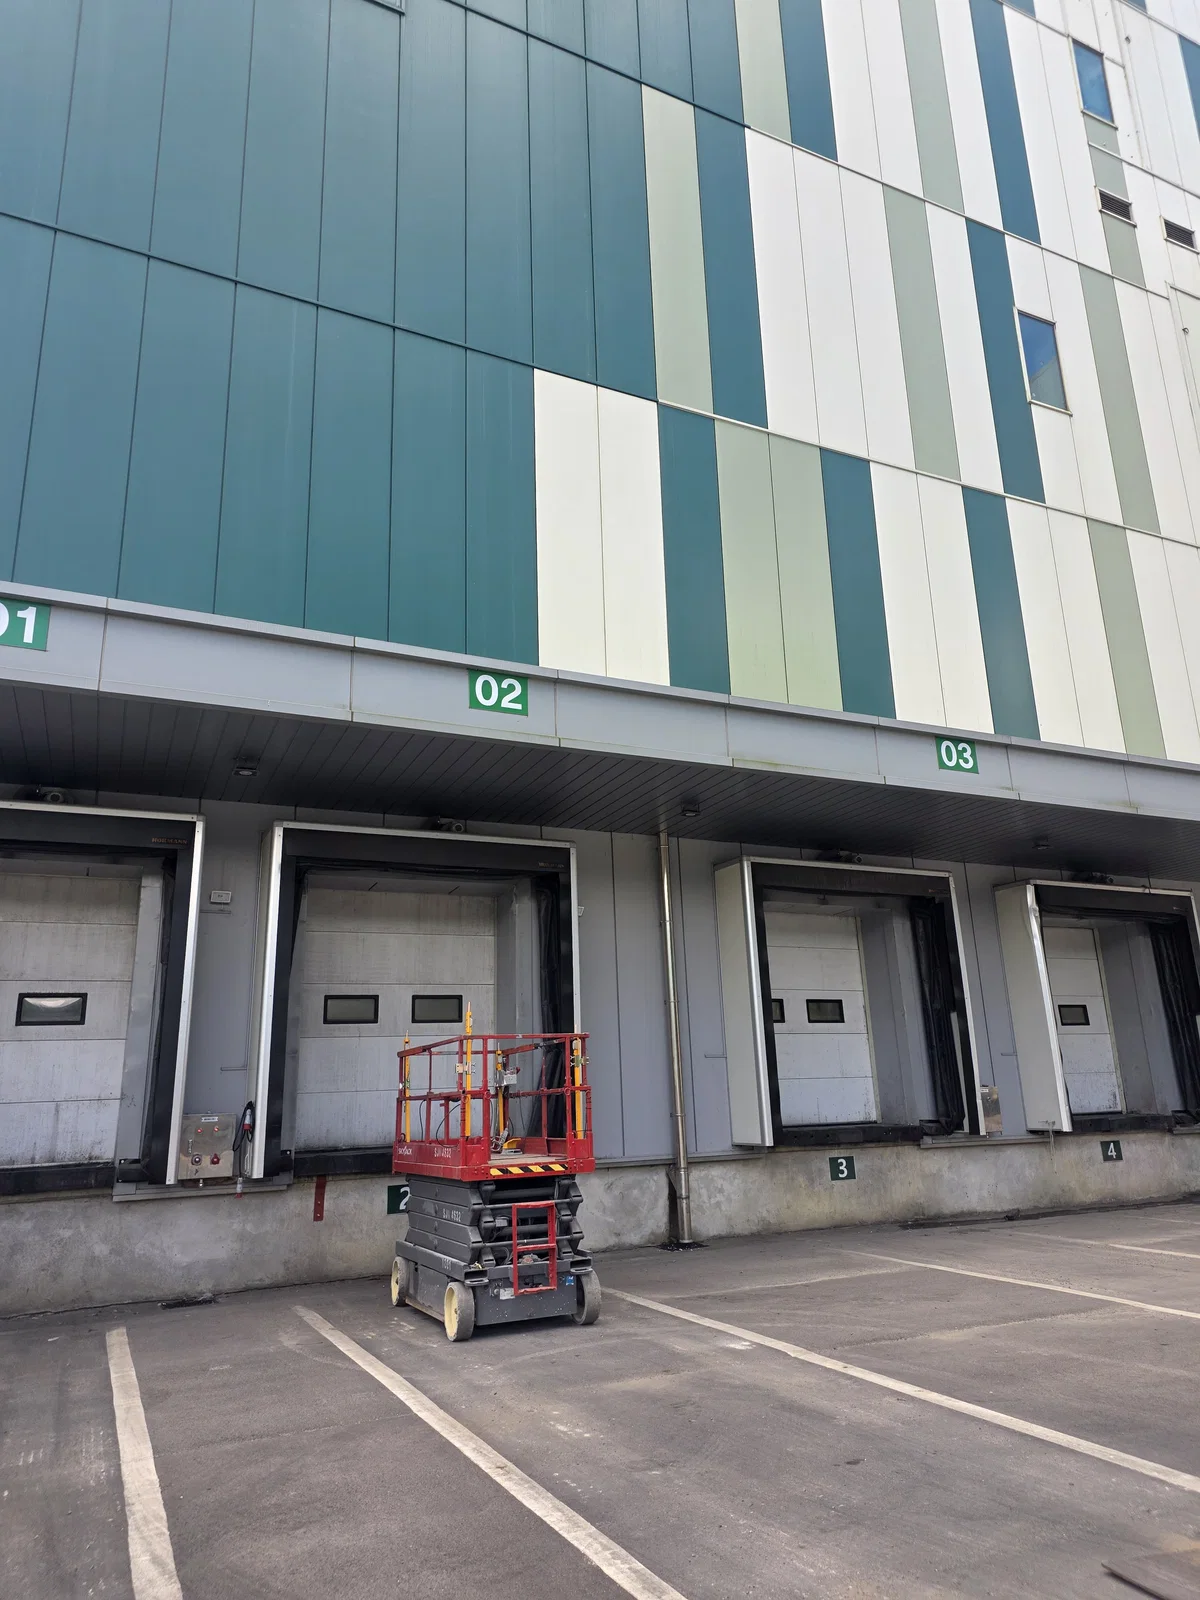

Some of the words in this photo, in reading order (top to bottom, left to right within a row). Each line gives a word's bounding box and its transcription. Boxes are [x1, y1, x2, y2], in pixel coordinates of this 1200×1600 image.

[475, 674, 523, 710] 02
[940, 740, 974, 769] 03
[1107, 1142, 1117, 1159] 4
[837, 1158, 848, 1178] 3
[399, 1186, 412, 1210] 2
